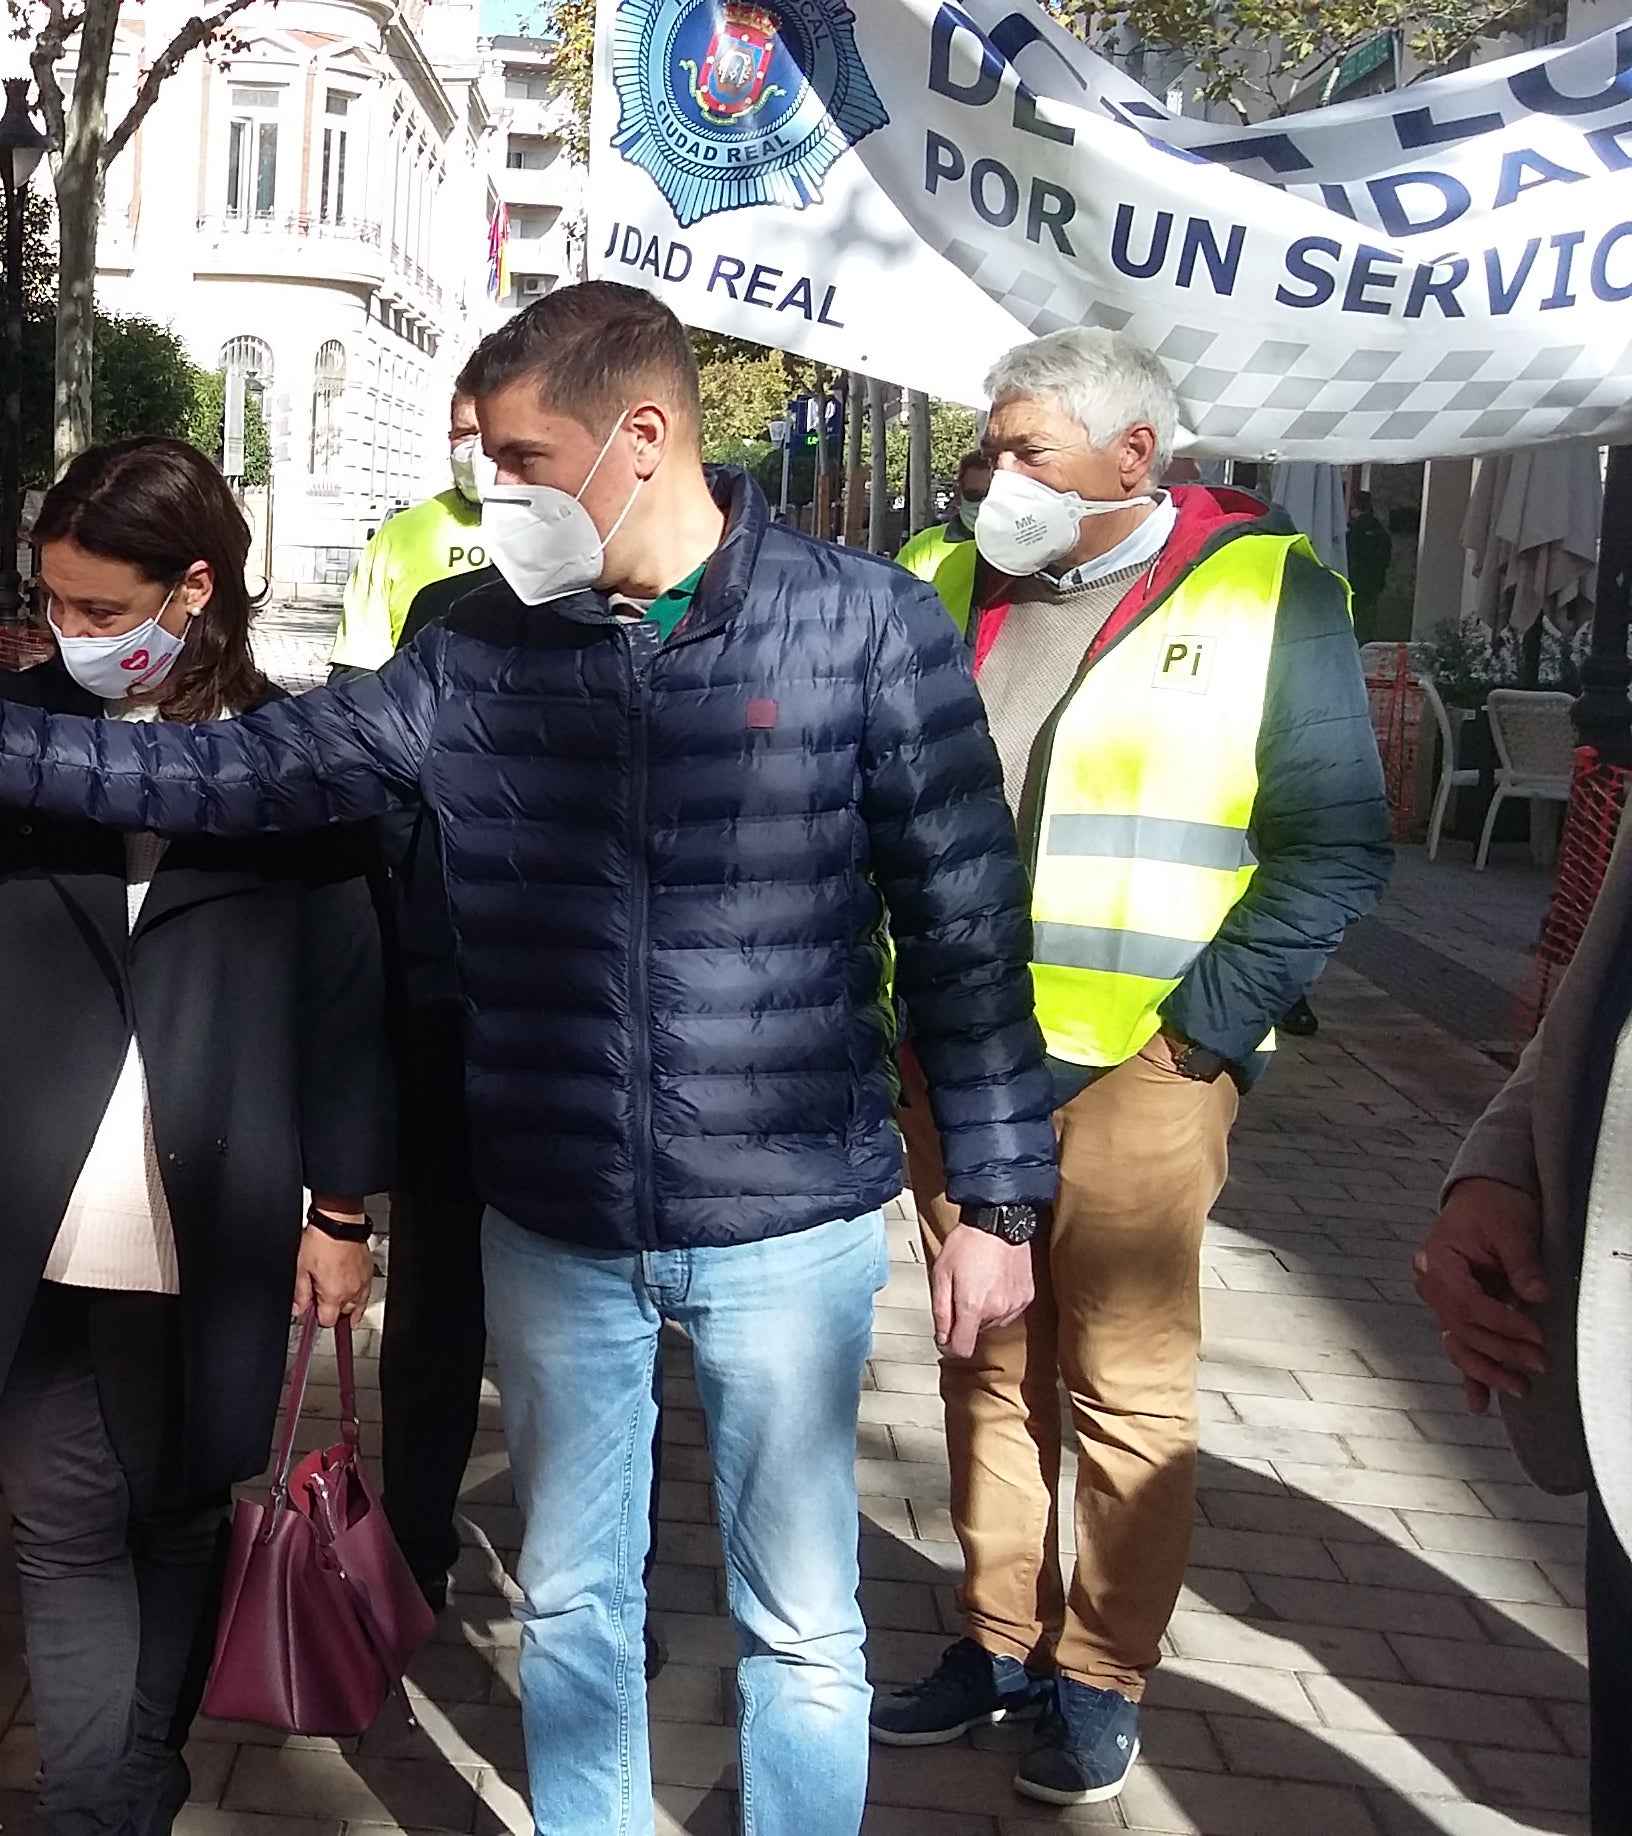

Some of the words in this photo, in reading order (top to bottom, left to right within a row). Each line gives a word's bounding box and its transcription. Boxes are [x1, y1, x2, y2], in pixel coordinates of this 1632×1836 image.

[657, 99, 718, 162] CIUDAD
[727, 134, 792, 164] REAL
[925, 128, 1077, 258] POR
[1110, 202, 1247, 296] UN
[706, 254, 845, 329] REAL
[1015, 514, 1036, 530] MK
[448, 545, 493, 568] PO
[1162, 643, 1202, 676] Pi
